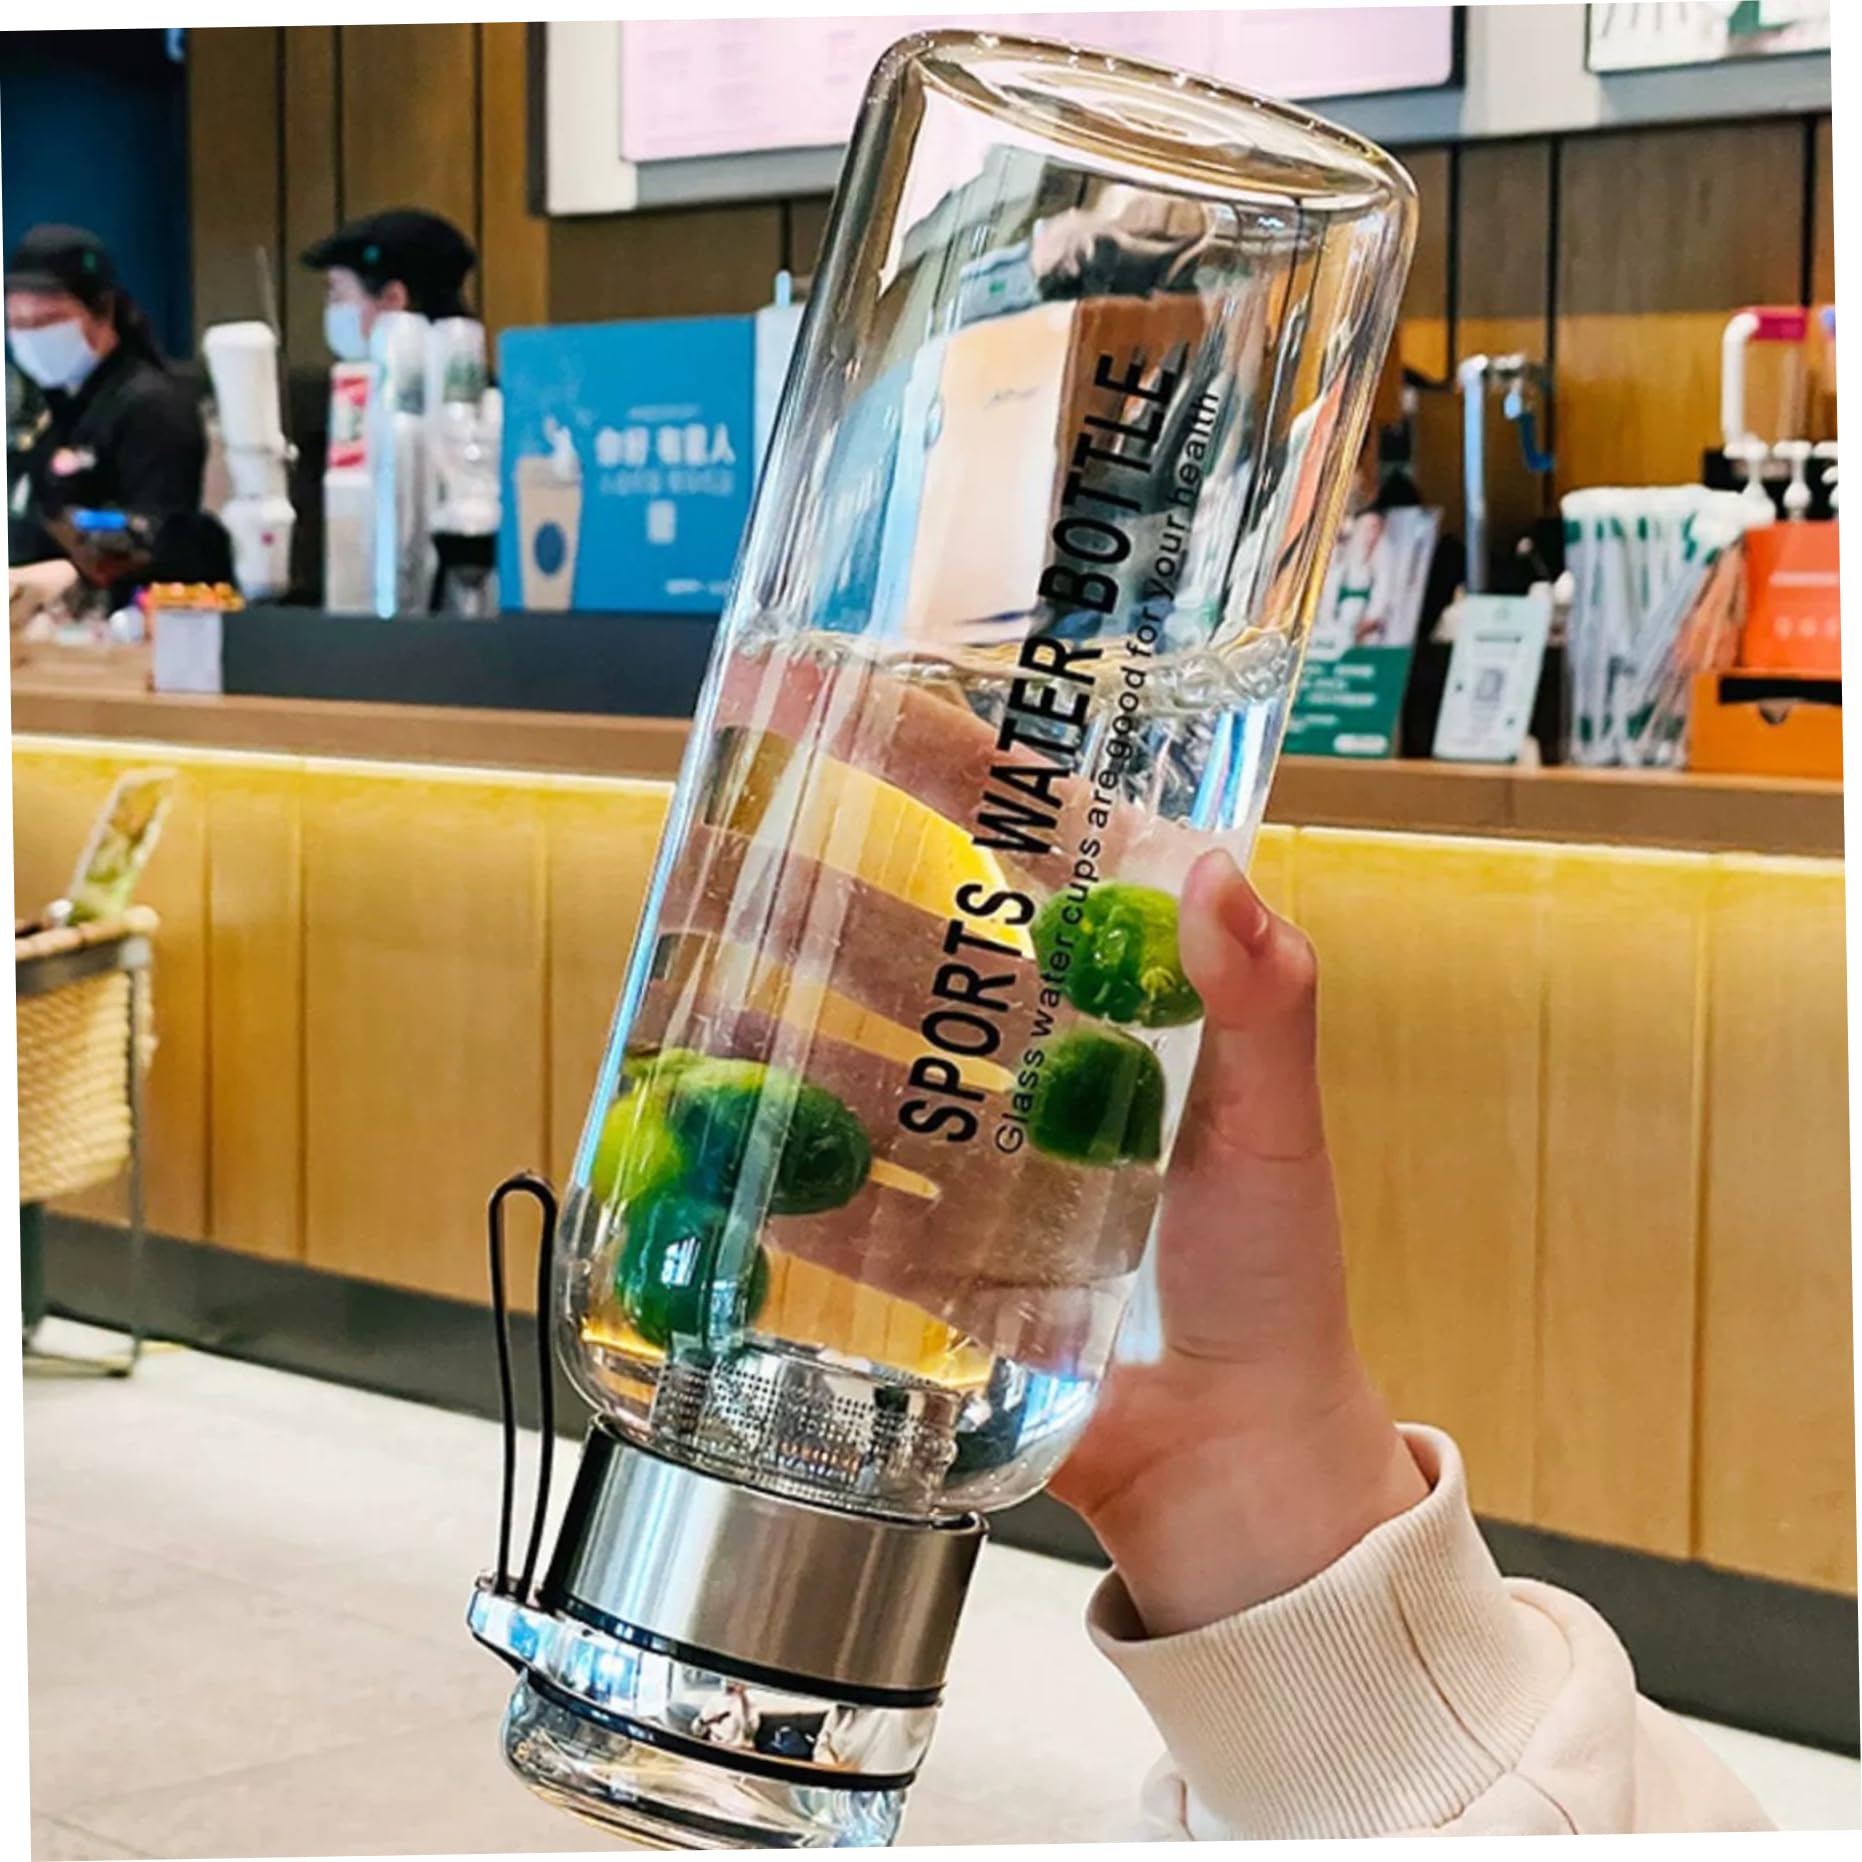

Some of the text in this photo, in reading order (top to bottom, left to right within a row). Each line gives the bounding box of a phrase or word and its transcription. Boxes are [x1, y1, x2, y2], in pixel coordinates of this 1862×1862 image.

[1146, 514, 1187, 600] your
[1126, 606, 1161, 659] for
[898, 354, 1177, 1143] SPORTS WATER BOTTLE
[1107, 666, 1146, 763] good
[1088, 770, 1119, 830] are
[1062, 838, 1102, 926] cups
[1030, 936, 1076, 1038] water
[995, 1048, 1045, 1154] Glass
